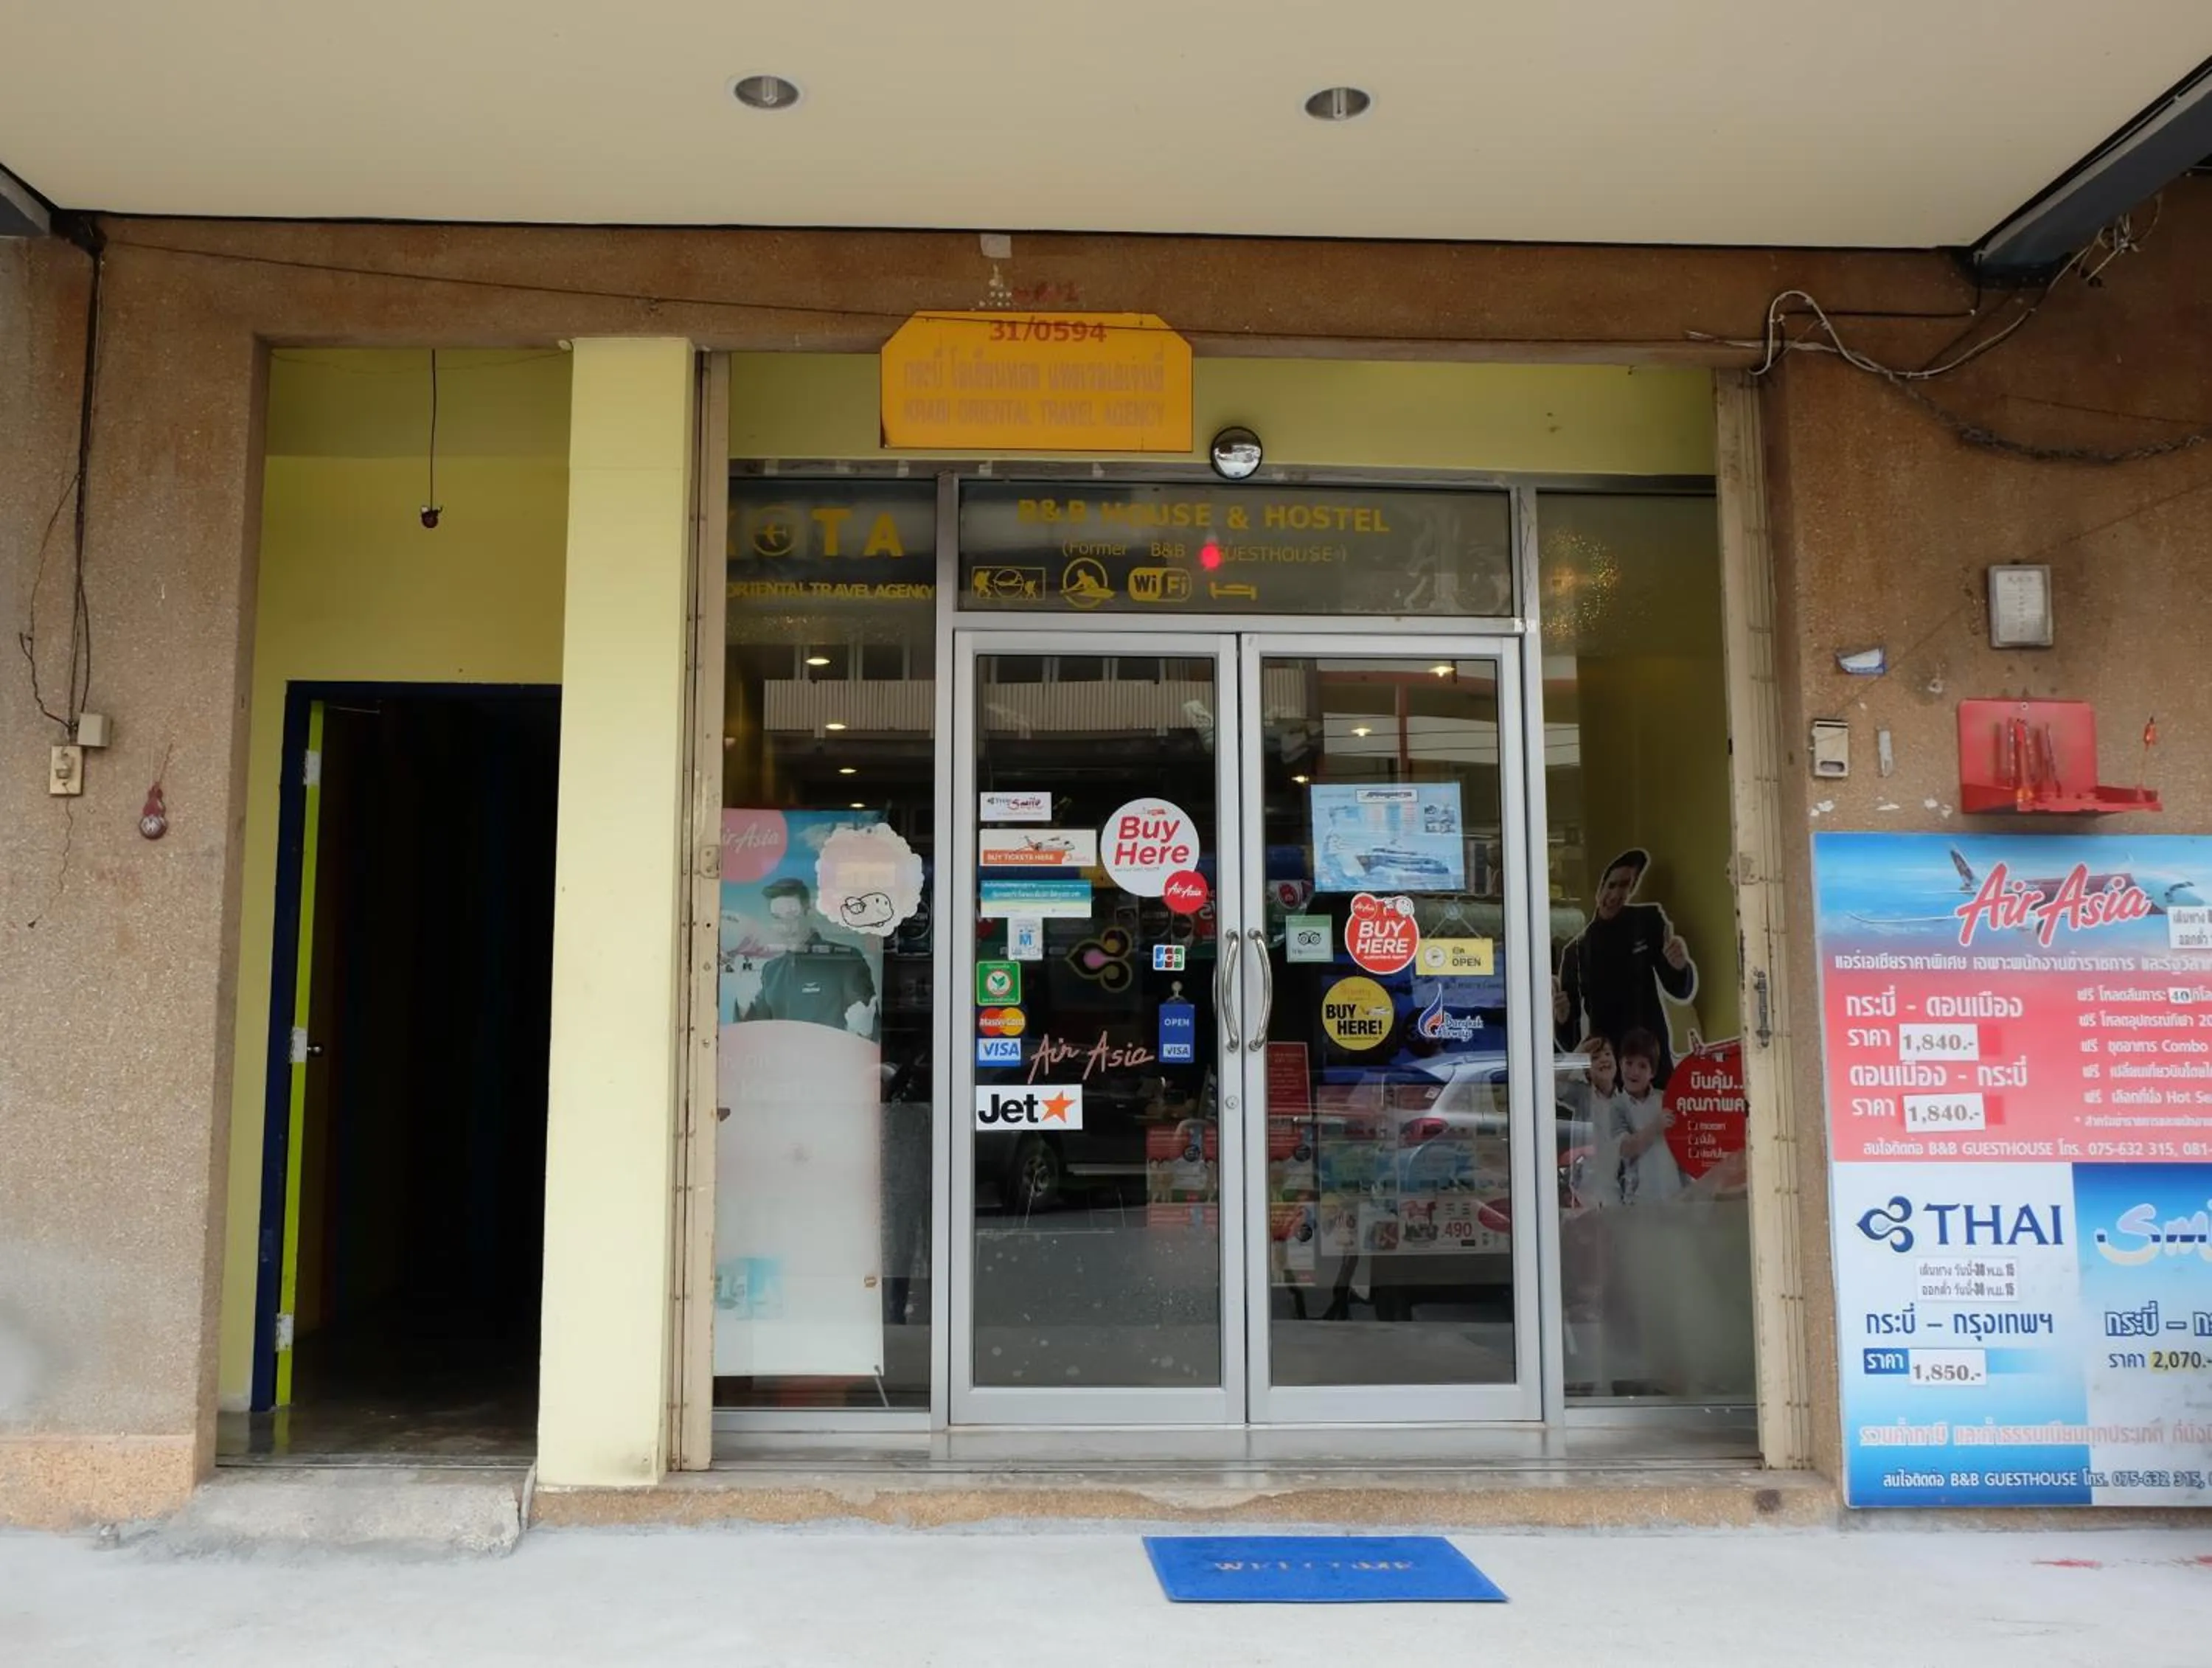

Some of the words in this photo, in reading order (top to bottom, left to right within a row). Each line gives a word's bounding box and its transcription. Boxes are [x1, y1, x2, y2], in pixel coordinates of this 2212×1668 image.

[990, 316, 1107, 342] 31/0594
[1039, 400, 1096, 426] TRAVEL
[1018, 498, 1087, 524] B&B
[1227, 506, 1250, 530] &
[1265, 504, 1391, 534] HOSTEL
[1151, 542, 1186, 558] B&B
[810, 583, 869, 600] TRAVEL
[1119, 816, 1180, 842] Buy
[1114, 841, 1190, 866] Here
[1358, 920, 1407, 939] BUY
[1356, 938, 1411, 955] HERE
[1452, 958, 1481, 967] OPEN
[1846, 985, 1896, 1017] กระบี่
[1926, 990, 2024, 1018] ดอนเมือง
[1325, 1004, 1357, 1020] BUY
[1164, 1018, 1190, 1027] OPEN
[1337, 1020, 1383, 1035] HERE!
[1848, 1028, 1892, 1047] ราคา
[2161, 1039, 2209, 1053] Combo
[983, 1041, 1020, 1057] VISA
[1166, 1046, 1189, 1055] VISA
[1849, 1060, 1947, 1087] ดอนเมือง
[1978, 1056, 2028, 1088] กระบี่
[2166, 1091, 2191, 1104] Hot
[978, 1094, 1039, 1124] Jet
[1851, 1098, 1896, 1117] ราคา
[1908, 1104, 1980, 1125] 1,840.-
[1928, 1142, 1958, 1156] B&B
[1962, 1141, 2053, 1156] GUESTHOUSE
[1922, 1202, 2064, 1245] THAI
[1865, 1303, 1916, 1334] กระบี่
[1954, 1313, 2054, 1342] กรุงเทพฯ
[2104, 1300, 2160, 1337] กระบี่
[1866, 1352, 1905, 1370] ราคา
[1913, 1364, 1982, 1383] 1,850.-
[2109, 1352, 2146, 1369] ราคา
[1950, 1473, 1980, 1487] B&B
[1984, 1473, 2078, 1487] GUESTHOUSE
